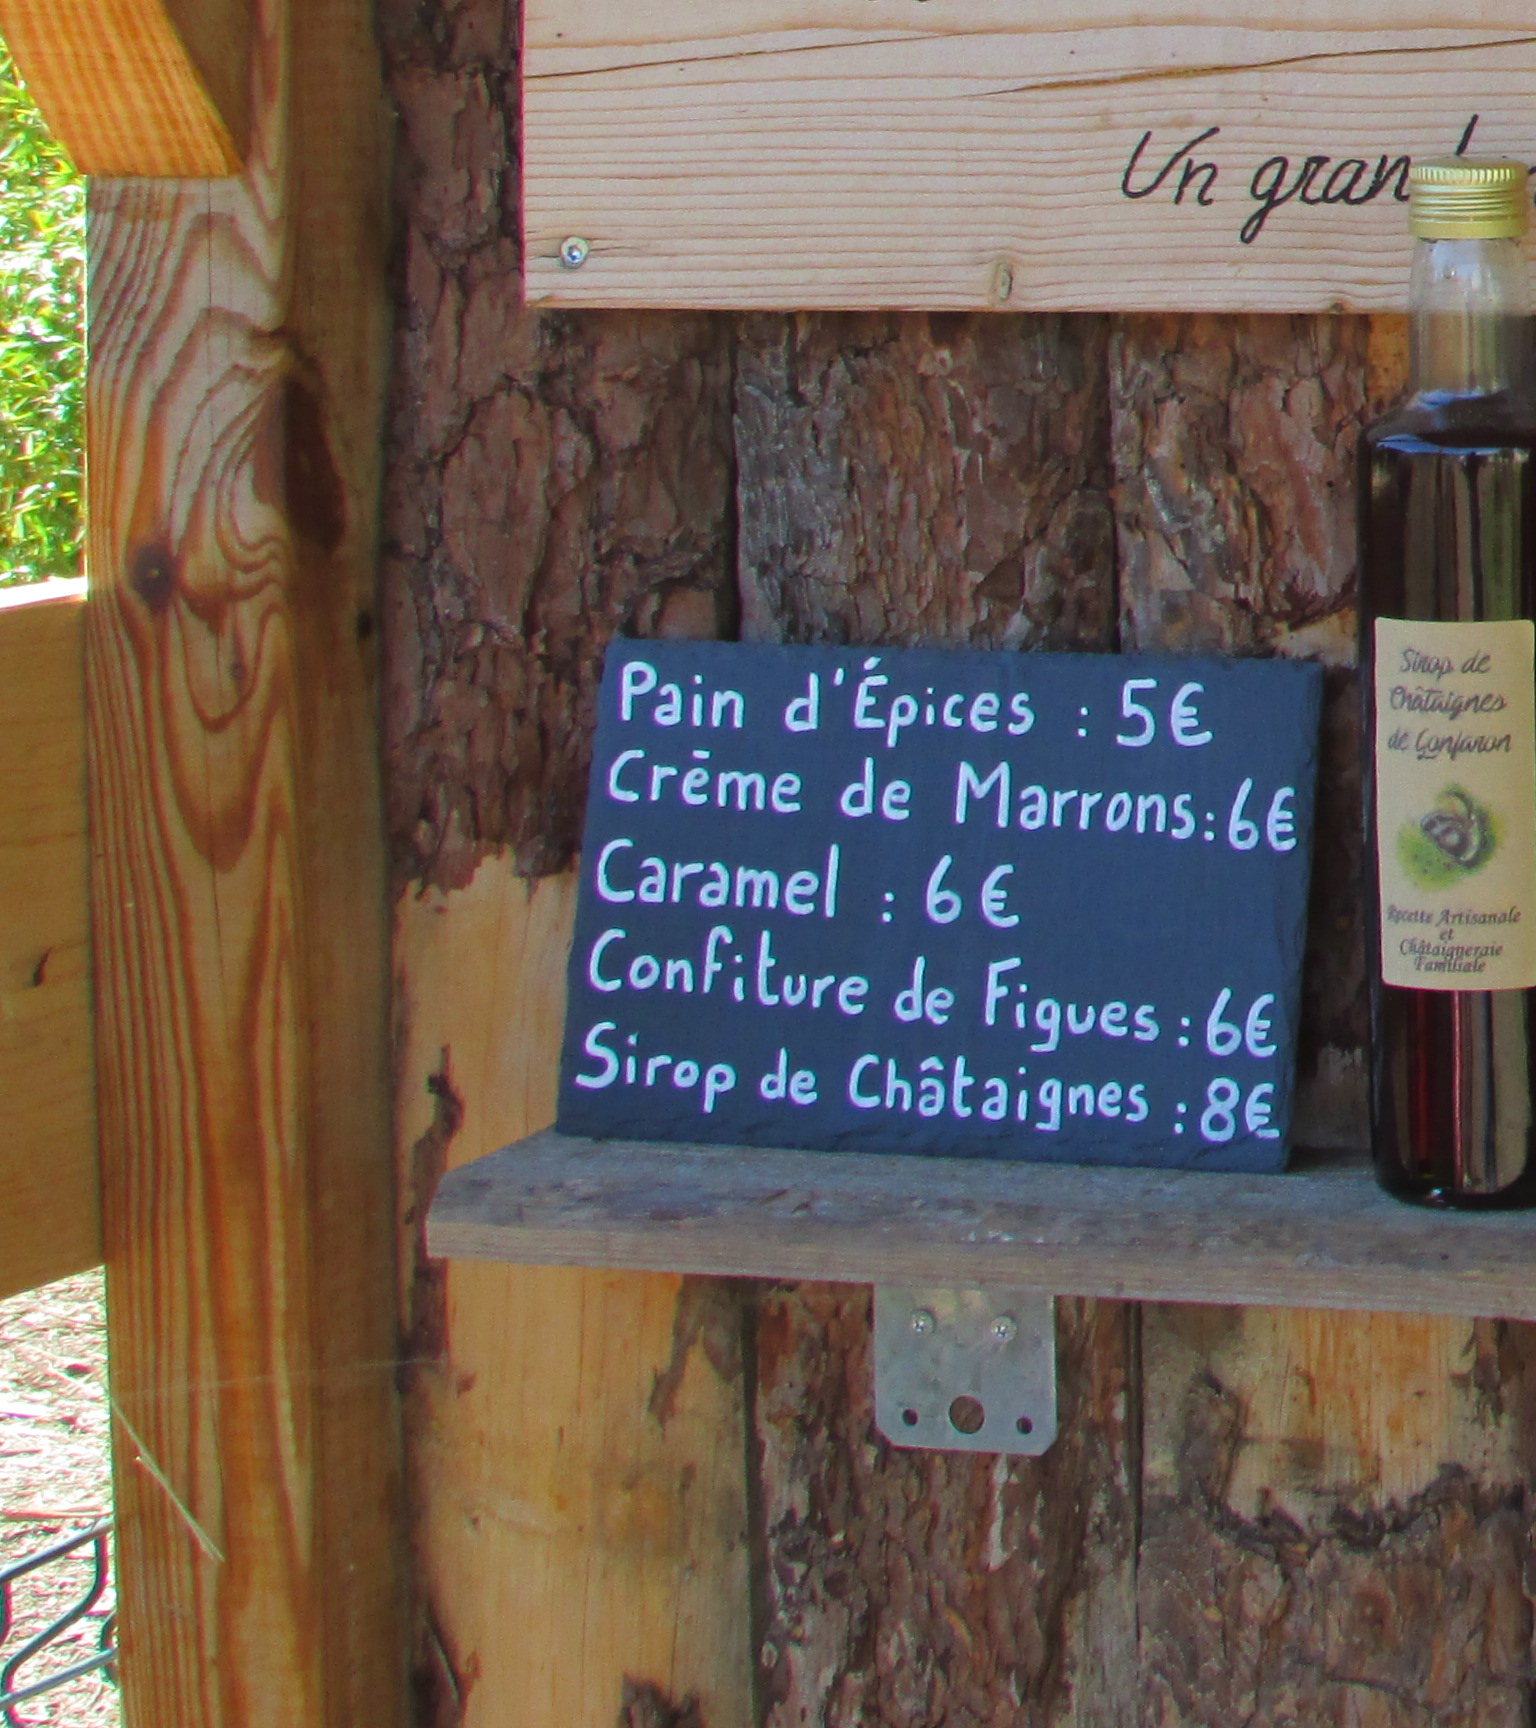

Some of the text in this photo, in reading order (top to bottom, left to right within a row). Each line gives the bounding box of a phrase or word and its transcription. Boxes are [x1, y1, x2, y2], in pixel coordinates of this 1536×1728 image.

[1120, 126, 1220, 207] Un
[1241, 113, 1480, 246] gran
[620, 659, 746, 731] Pain
[783, 655, 1038, 749] d'Épices
[1401, 647, 1492, 682] Sirop de
[839, 756, 914, 823] de
[597, 838, 842, 921] Caramel
[587, 924, 872, 1019] Confiture
[892, 954, 956, 1027] de
[574, 1021, 738, 1113] Sirop
[758, 1048, 820, 1107] de
